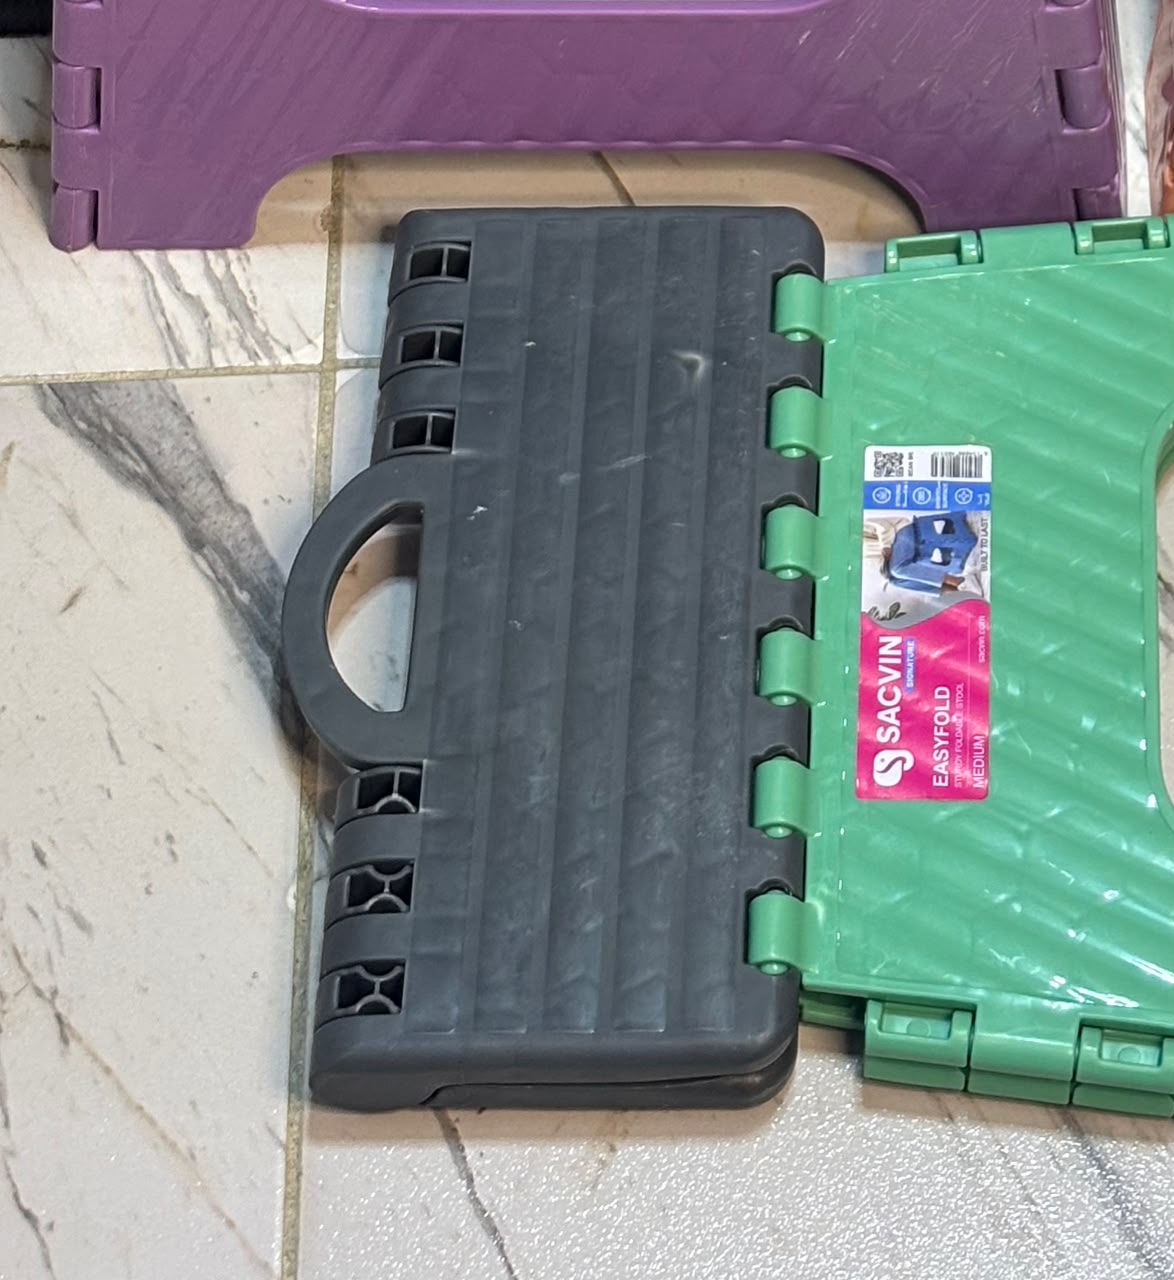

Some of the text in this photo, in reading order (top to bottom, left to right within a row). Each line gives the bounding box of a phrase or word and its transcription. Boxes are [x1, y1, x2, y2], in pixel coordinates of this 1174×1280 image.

[980, 537, 989, 549] TO
[981, 517, 989, 536] LAST
[980, 551, 989, 572] BUILT
[978, 615, 987, 663] sacvin.com
[906, 639, 915, 689] SIGNATURE
[876, 635, 903, 744] SACVIN
[954, 682, 965, 709] STOOL
[932, 686, 950, 788] EASYFOLD
[954, 754, 963, 788] STURDY
[973, 735, 985, 788] MEDIUM
